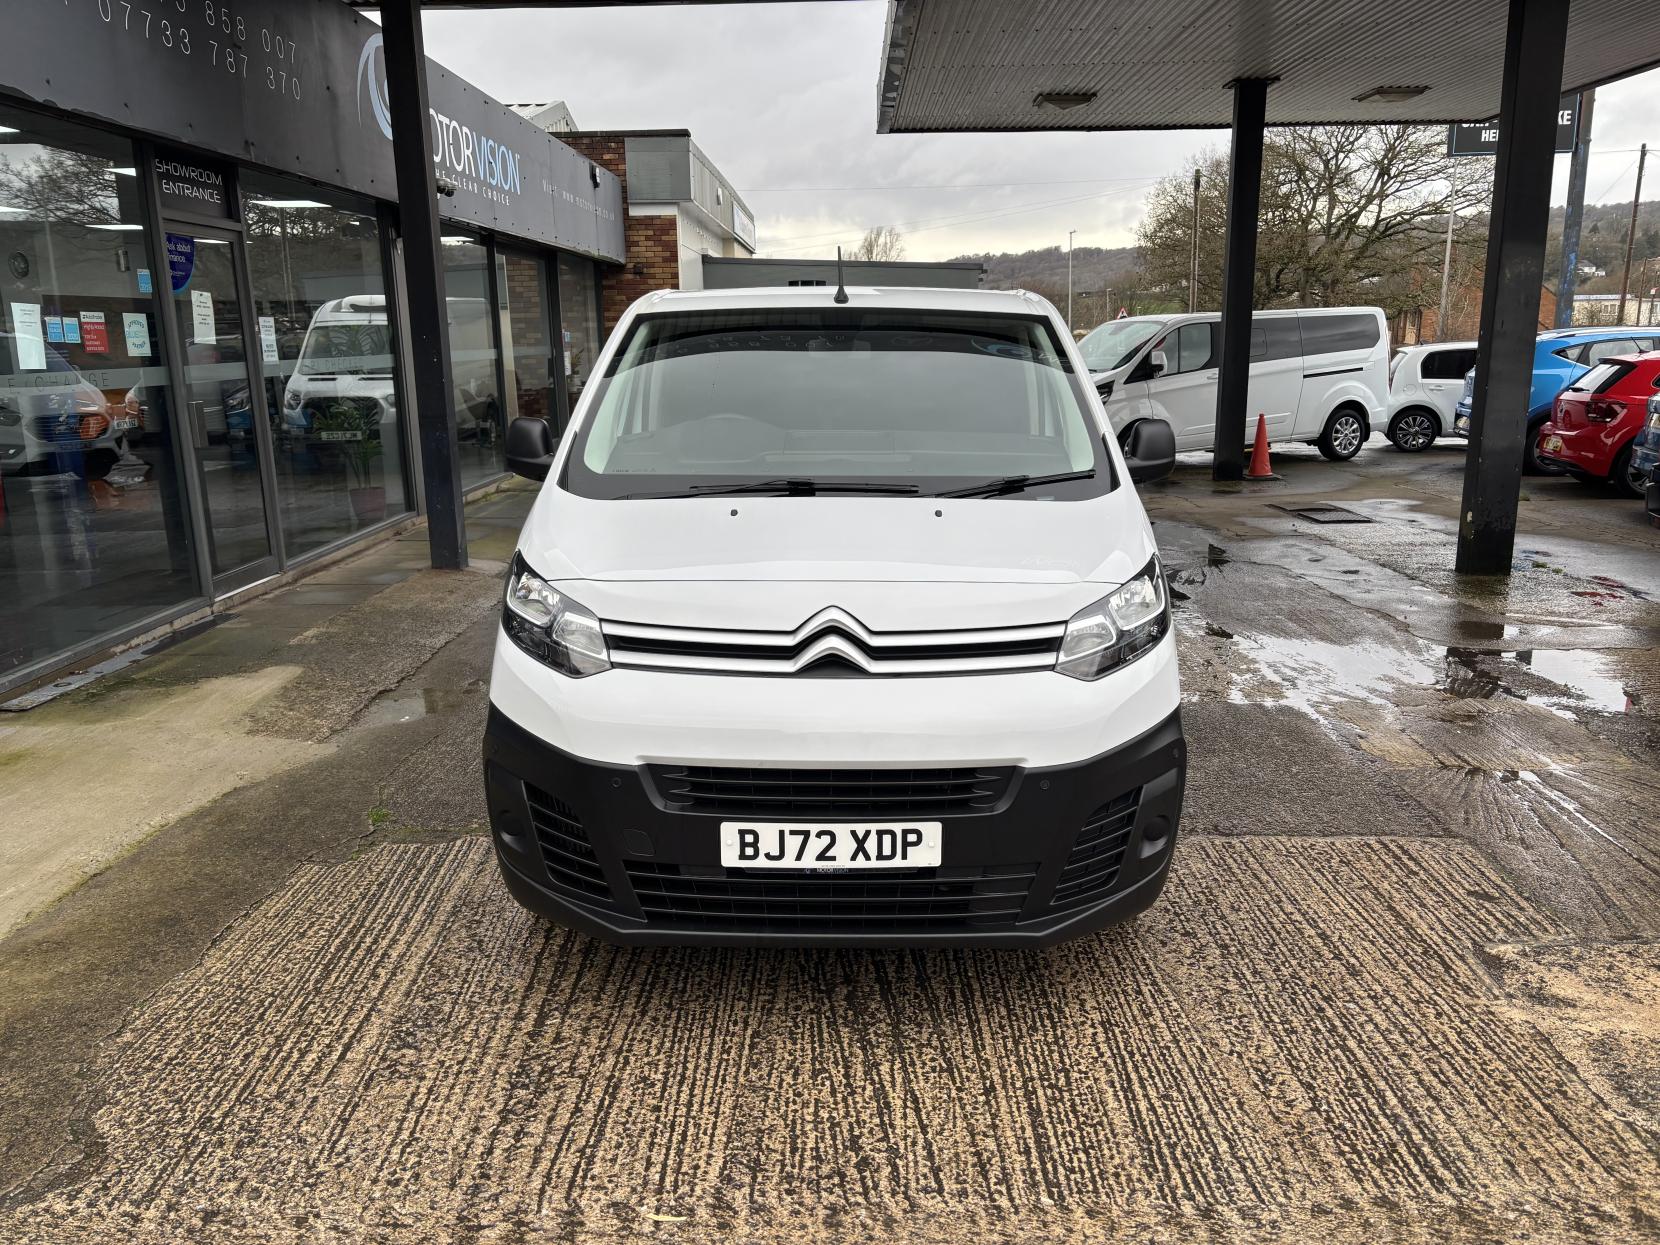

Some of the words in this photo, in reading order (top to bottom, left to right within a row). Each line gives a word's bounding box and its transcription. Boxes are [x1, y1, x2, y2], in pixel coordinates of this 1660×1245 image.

[205, 1, 246, 41] 858
[261, 29, 296, 64] 007
[98, 0, 191, 55] 07733
[209, 40, 248, 78] 787
[266, 66, 300, 100] 370
[155, 159, 222, 186] SHOWROOM
[162, 180, 221, 203] ENTRANCE
[737, 829, 837, 862] BJ72
[849, 828, 923, 862] XDP
